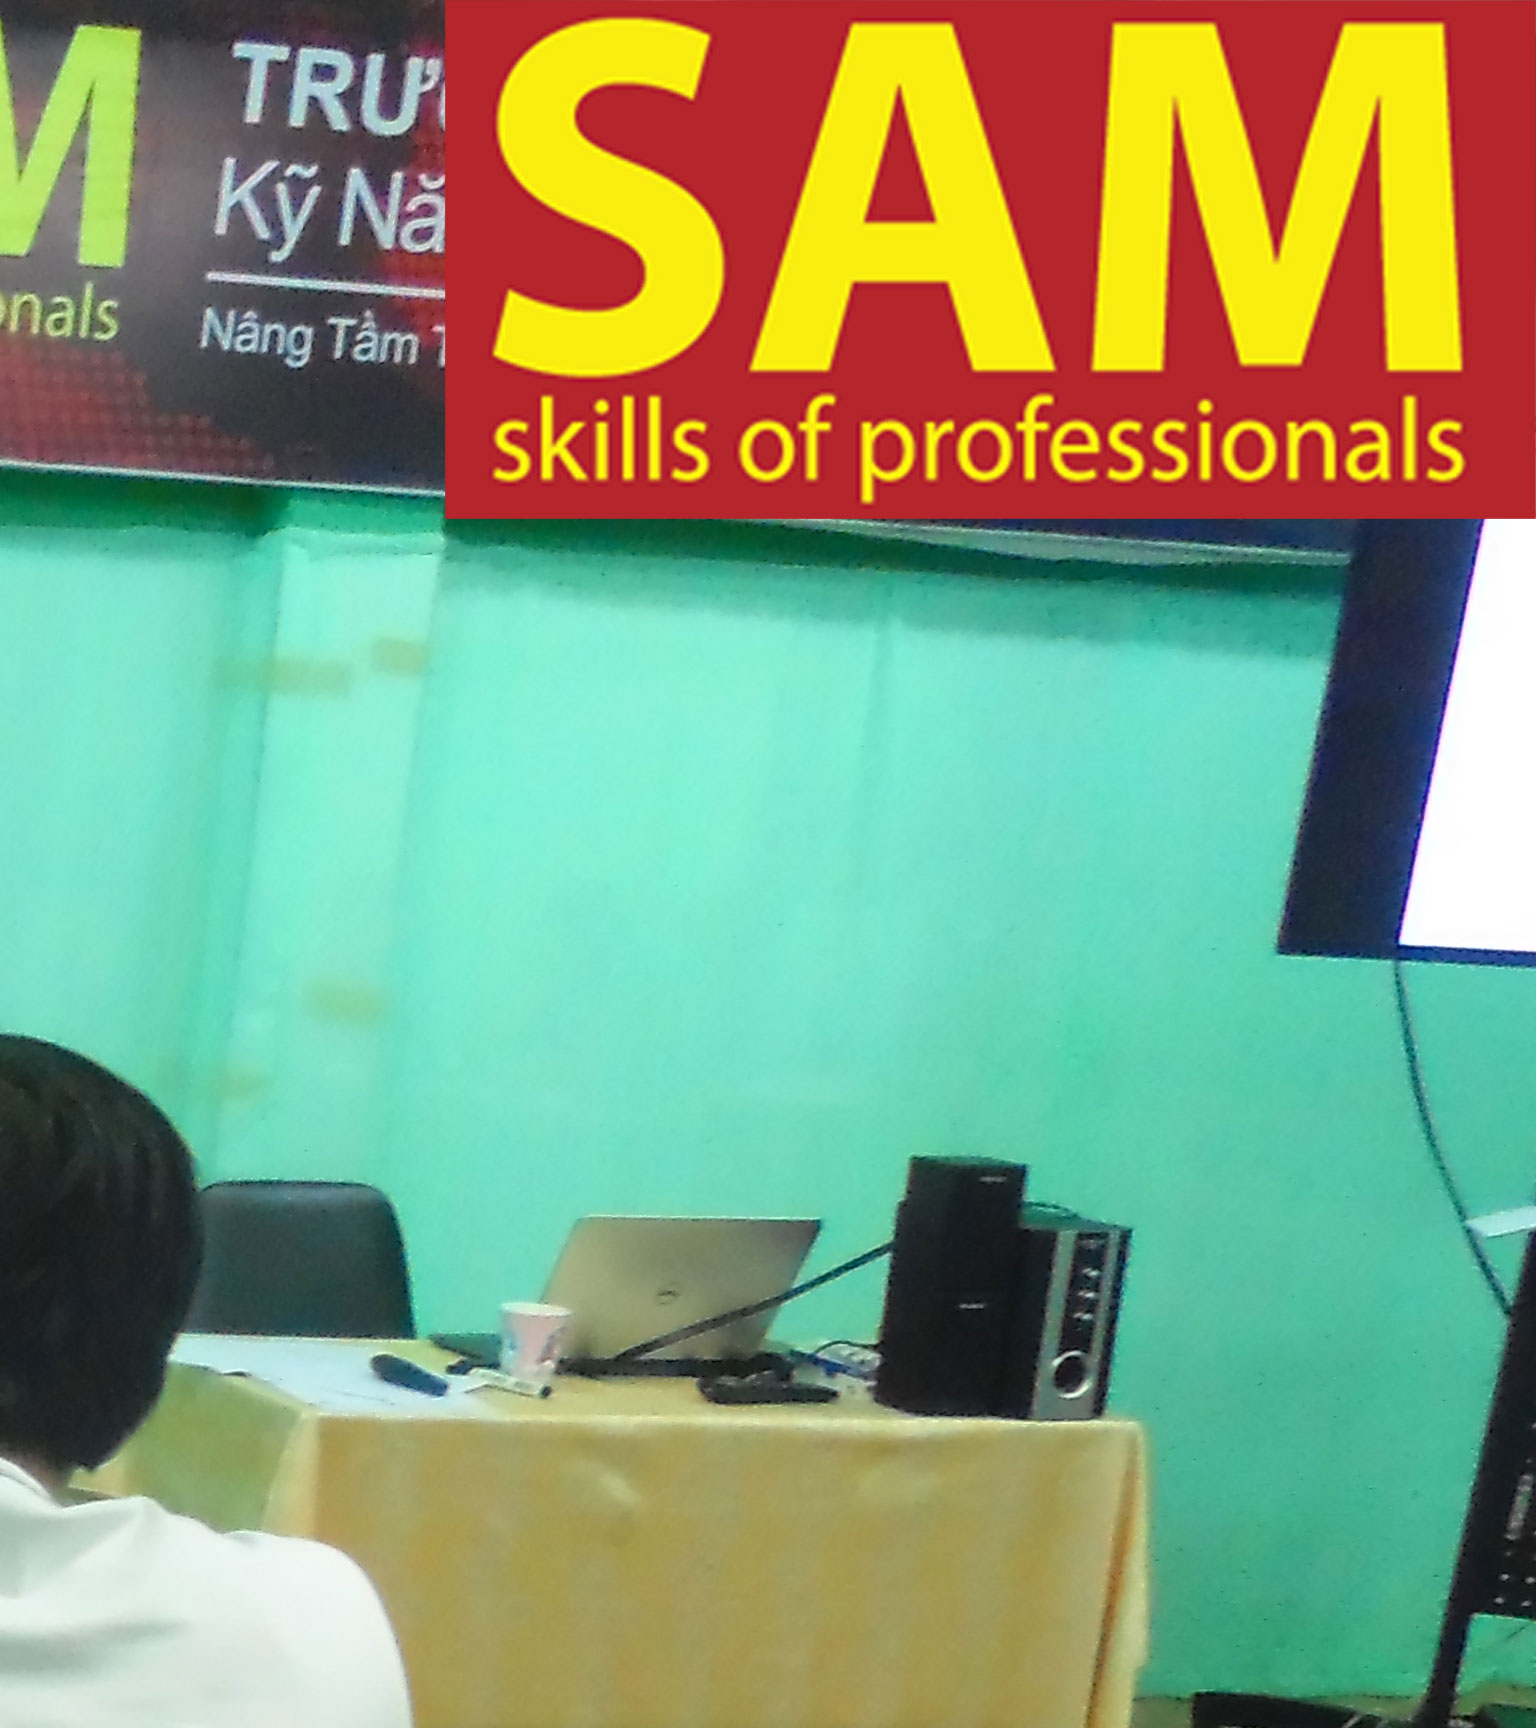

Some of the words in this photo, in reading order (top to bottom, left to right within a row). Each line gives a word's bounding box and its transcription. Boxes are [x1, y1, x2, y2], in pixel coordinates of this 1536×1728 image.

[231, 41, 445, 136] TRƯ
[214, 156, 322, 263] Kỹ
[199, 305, 315, 370] Nâng
